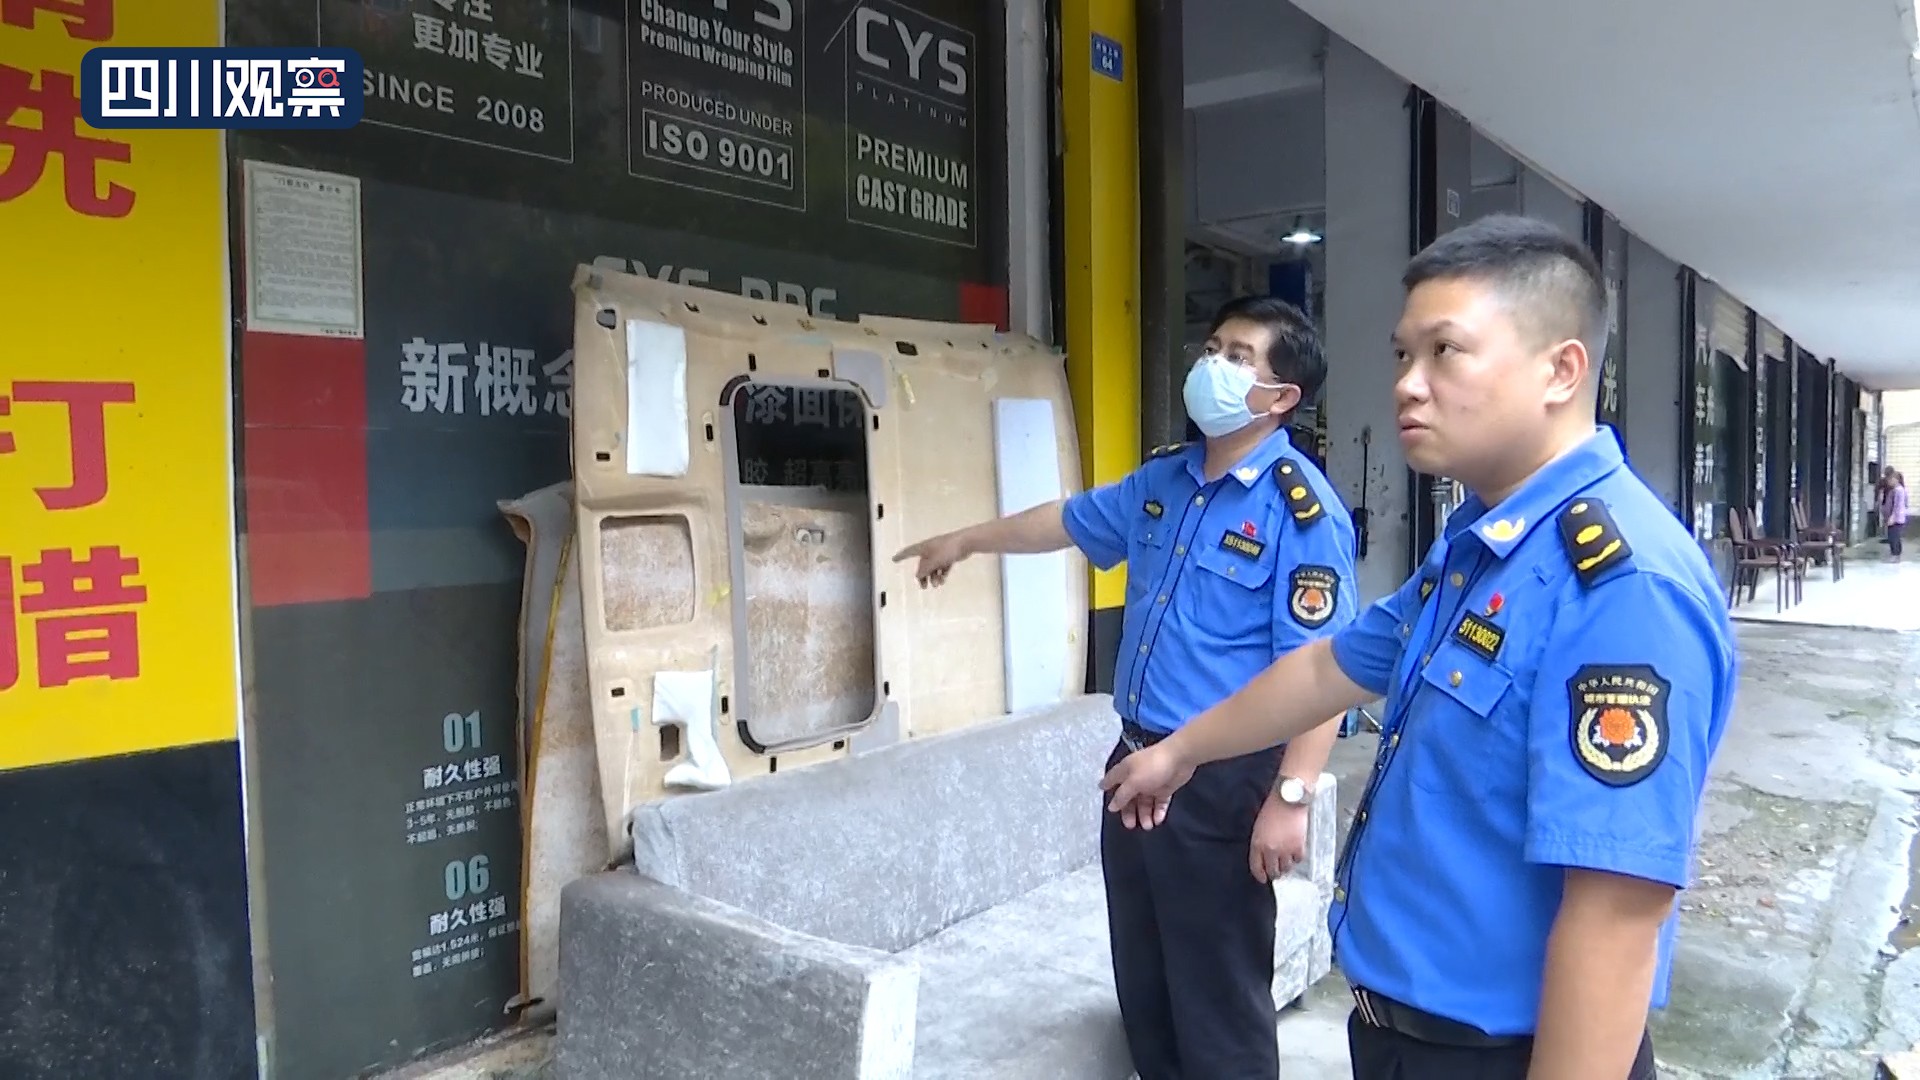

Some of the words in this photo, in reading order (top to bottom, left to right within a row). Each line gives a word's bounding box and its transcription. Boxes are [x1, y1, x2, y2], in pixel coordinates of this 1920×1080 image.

[412, 12, 544, 79] 更加专业
[640, 0, 710, 39] Change
[712, 19, 751, 52] Your
[752, 33, 793, 66] Style
[855, 6, 967, 95] CYS
[702, 43, 765, 80] Wrapping
[766, 64, 792, 88] Film
[363, 68, 454, 114] SINCE
[476, 95, 545, 133] 2008
[641, 80, 736, 121] PRODUCED
[738, 107, 793, 137] UNDER
[856, 81, 967, 128] PLATINUM
[649, 119, 709, 161] ISO
[718, 137, 789, 180] 9001
[856, 132, 968, 190] PREMIUM
[856, 173, 907, 215] CAST
[910, 187, 968, 230] GRADE
[442, 710, 483, 753] 01
[422, 754, 501, 790] 耐久性强
[445, 855, 490, 901] 06
[429, 895, 507, 936] 耐久性强
